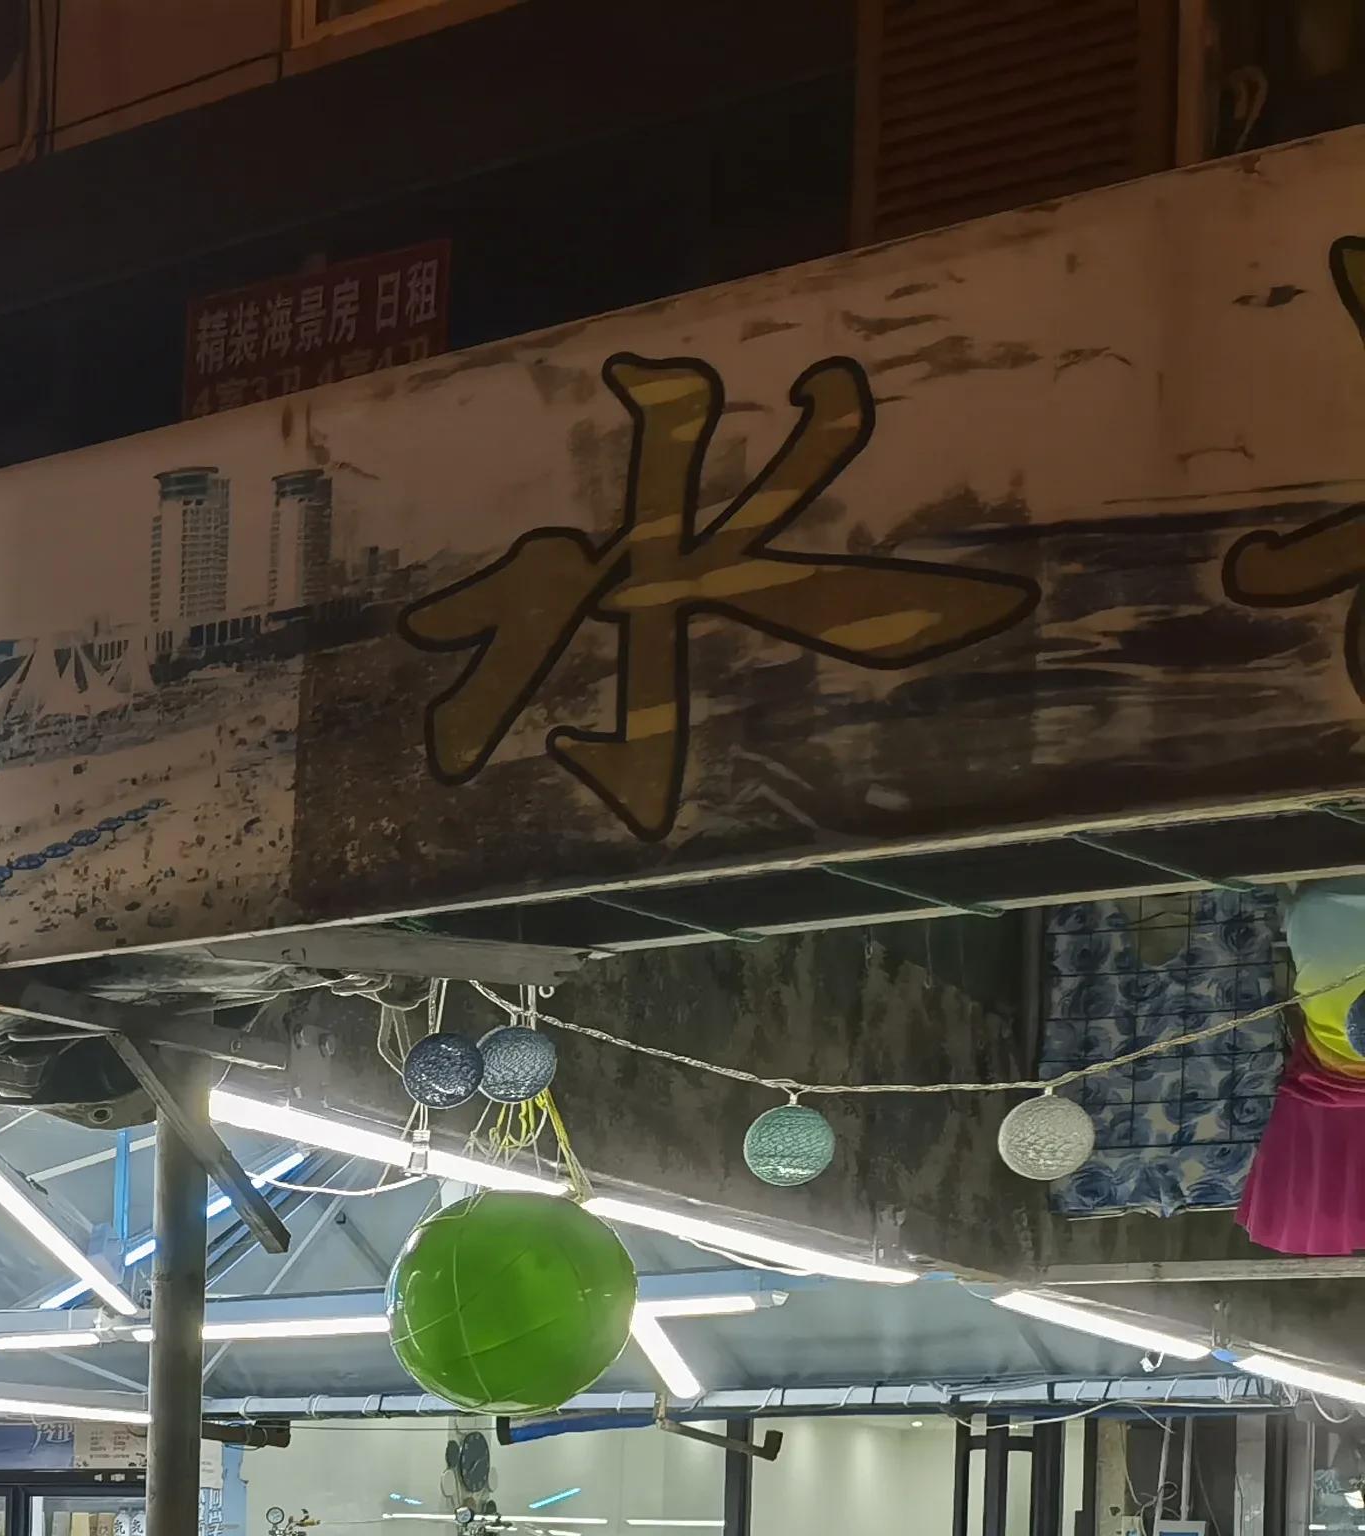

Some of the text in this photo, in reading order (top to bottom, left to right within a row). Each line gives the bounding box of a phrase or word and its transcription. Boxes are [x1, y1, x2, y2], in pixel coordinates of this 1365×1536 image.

[195, 259, 439, 374] 精装海景房 日租
